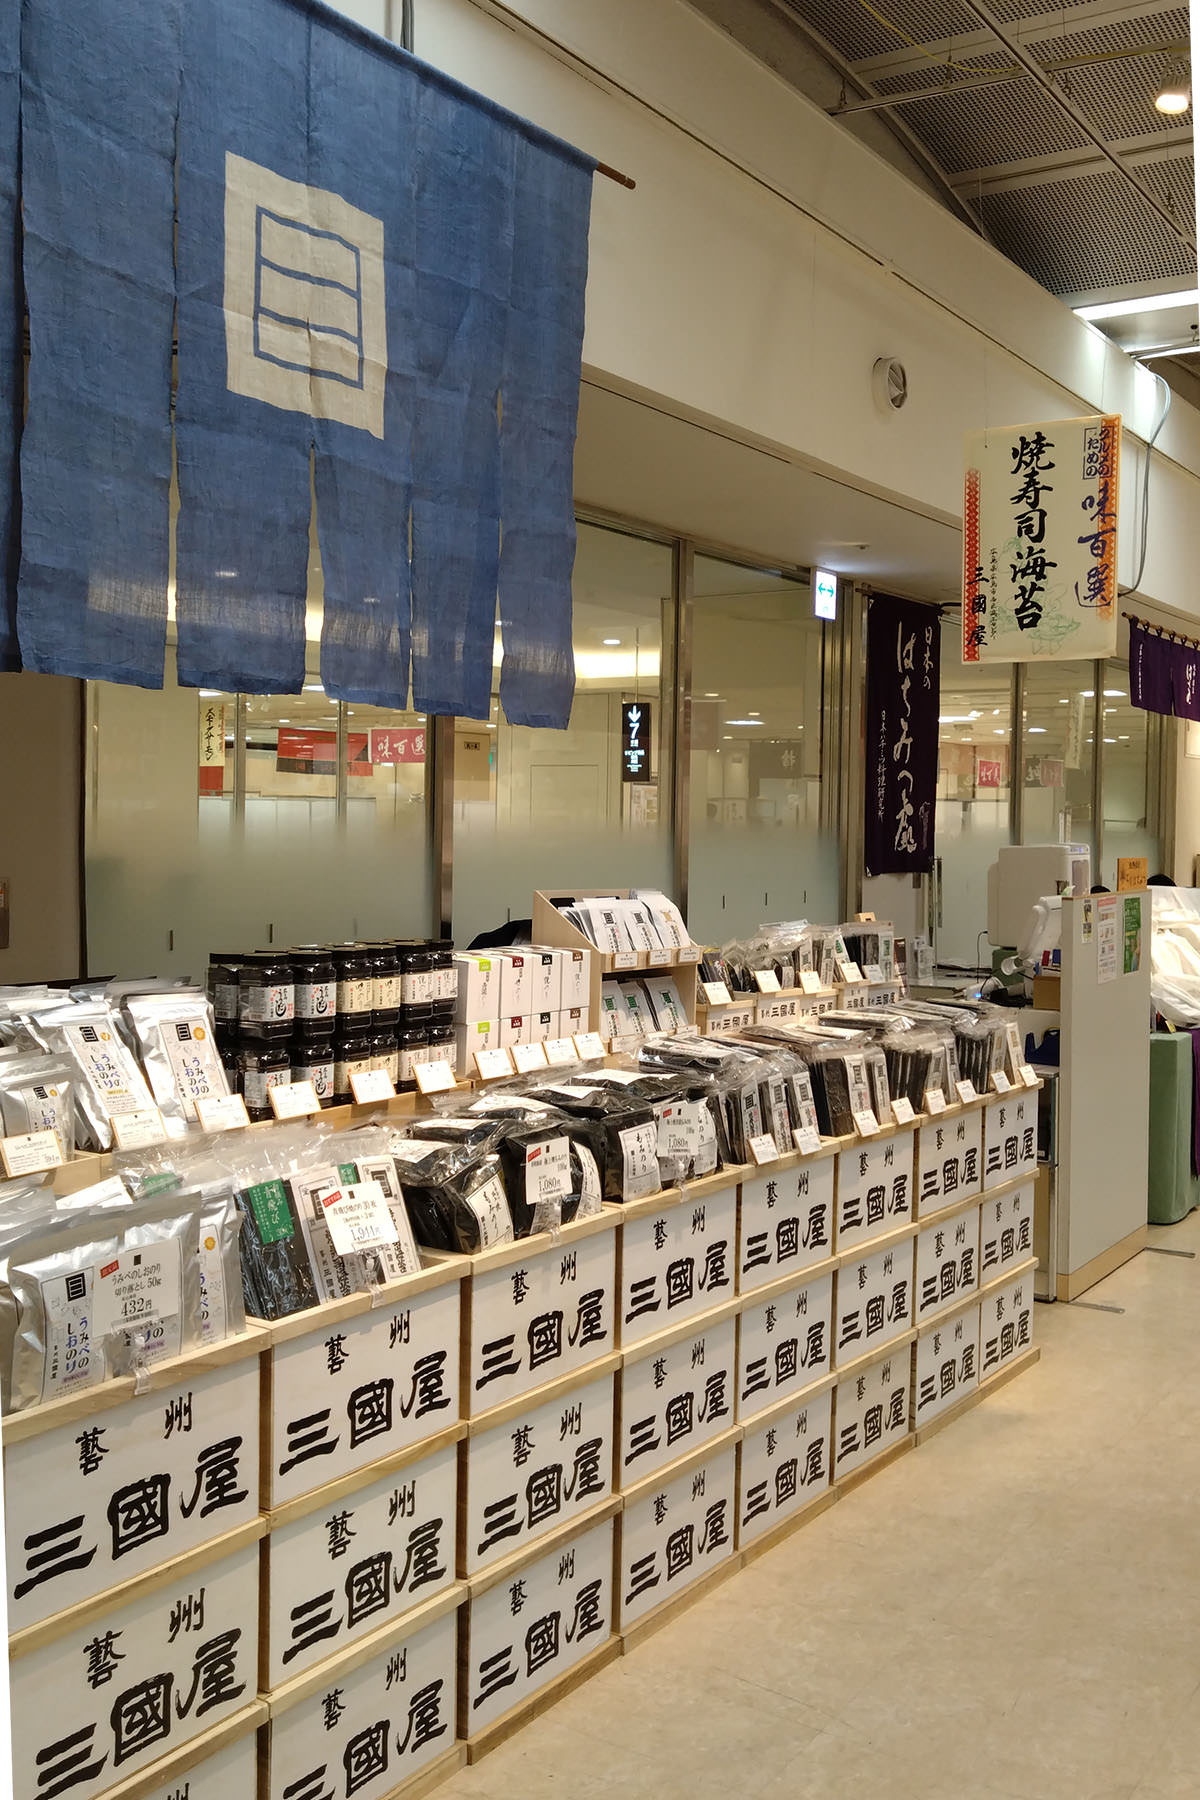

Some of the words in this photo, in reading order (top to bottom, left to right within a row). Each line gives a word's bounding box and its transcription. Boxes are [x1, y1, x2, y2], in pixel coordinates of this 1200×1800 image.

[1009, 431, 1058, 632] 焼寿司海苔
[1074, 479, 1118, 609] 味百選
[378, 734, 426, 759] 味百選
[722, 1013, 751, 1030] 三國屋
[771, 1001, 797, 1019] 三國屋
[810, 1001, 834, 1017] 三國屋
[89, 1054, 114, 1089] しおのり
[182, 1058, 200, 1096] しおのり
[192, 1056, 210, 1094] うみべの
[859, 1144, 894, 1177] 藝州
[920, 1147, 978, 1201] 三國屋
[985, 1127, 1034, 1173] 三國屋
[766, 1171, 809, 1210] 藝州
[839, 1175, 908, 1233] 三國屋
[653, 1204, 705, 1250] 藝州
[743, 1204, 828, 1273] 三國屋
[983, 1217, 1030, 1272] 三國屋
[111, 1263, 161, 1287] うみべのしおのり
[511, 1251, 578, 1304] 藝州
[625, 1239, 730, 1324] 三國屋
[857, 1253, 893, 1289] 藝州
[919, 1248, 974, 1312] 三國屋
[121, 1297, 152, 1318] 432円
[475, 1288, 607, 1390] 三國屋
[765, 1289, 808, 1334] 藝州
[838, 1281, 908, 1348] 三國屋
[65, 1323, 78, 1374] しおのり
[78, 1316, 90, 1369] うみべの
[325, 1309, 411, 1376] 藝州
[653, 1338, 705, 1389] 藝州
[742, 1321, 827, 1400] 三國屋
[983, 1310, 1029, 1371] 三國屋
[856, 1361, 891, 1401] 藝州
[918, 1344, 975, 1411] 三國屋
[74, 1392, 193, 1476] 藝州
[278, 1350, 452, 1477] 三國屋
[512, 1403, 582, 1467] 藝州
[624, 1369, 729, 1466] 三國屋
[766, 1409, 808, 1457] 藝州
[837, 1387, 906, 1462] 三國屋
[477, 1437, 605, 1554] 三國屋
[654, 1470, 706, 1526] 藝州
[743, 1438, 826, 1526] 三國屋
[14, 1436, 248, 1599] 三國屋
[325, 1479, 416, 1560] 藝州
[509, 1548, 575, 1616] 藝州
[625, 1499, 728, 1605] 三國屋
[282, 1517, 447, 1665] 三國屋
[84, 1588, 205, 1690] 藝州
[473, 1579, 604, 1709] 三國屋
[34, 1628, 248, 1800] 三國屋
[322, 1648, 407, 1731] 藝州
[282, 1678, 447, 1800] 三國屋
